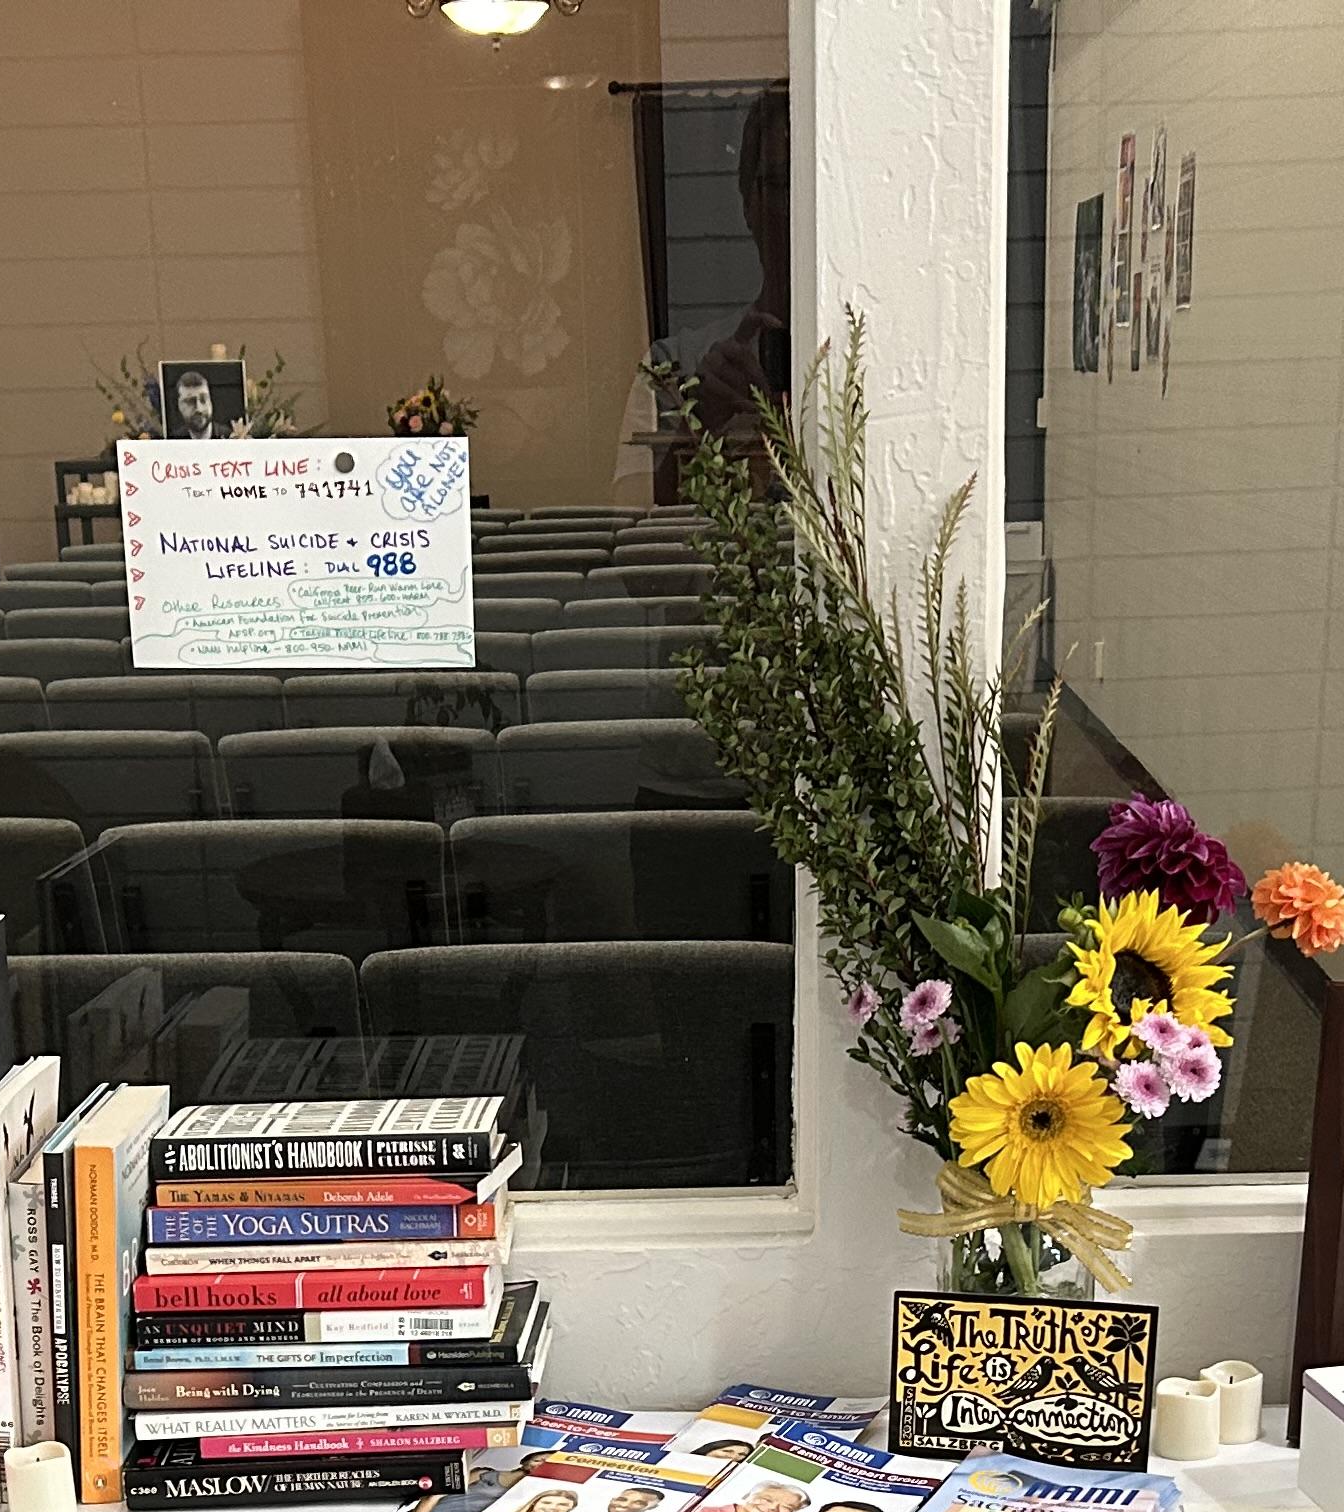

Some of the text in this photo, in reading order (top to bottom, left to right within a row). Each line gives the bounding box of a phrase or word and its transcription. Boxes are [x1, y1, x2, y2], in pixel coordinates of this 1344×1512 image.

[151, 461, 202, 483] CRISIS
[209, 460, 253, 477] TEXT
[220, 485, 268, 500] HOME
[294, 480, 375, 499] 741741
[159, 532, 258, 555] NATIONAL
[268, 533, 339, 549] SUICIDE
[370, 529, 431, 549] CRISIS
[325, 561, 360, 574] DIAL
[366, 552, 418, 577] 988
[161, 594, 283, 614] Other Resources
[238, 615, 295, 625] Foundation
[178, 1138, 283, 1172] ABOLITIONIST'S
[288, 1140, 363, 1169] HANDBOOK
[376, 1139, 437, 1154] PATRISSE
[377, 1153, 436, 1167] CULLORS
[169, 1190, 189, 1202] THE
[193, 1190, 234, 1202] YAMAS
[323, 1190, 364, 1203] Deborah
[366, 1190, 394, 1202] Adele
[165, 1215, 177, 1240] THE
[179, 1212, 192, 1242] PATH
[193, 1217, 204, 1235] OF
[206, 1215, 218, 1239] THE
[223, 1212, 389, 1236] YOGA SUTRAS
[237, 1257, 271, 1265] THINGS
[271, 1256, 293, 1265] FALL
[293, 1255, 321, 1264] APART
[155, 1283, 442, 1308] bell hooks all about love
[27, 1208, 47, 1426] ROSS GAY The Book of Delights
[143, 1320, 300, 1336] AN UNQUIET MIND
[952, 1309, 999, 1350] The
[1080, 1312, 1108, 1347] of
[95, 1274, 108, 1458] THE BRAIN THAT CHANGES ITSELF
[256, 1351, 394, 1365] THE GIFTS OF Imperfection
[897, 1338, 1009, 1396] Life is
[54, 1338, 70, 1405] APOCALYPSE
[175, 1383, 280, 1398] Being with Dying
[770, 1393, 818, 1407] NAMI
[565, 1407, 615, 1424] NAMI
[902, 1386, 915, 1441] SHARON
[946, 1394, 1005, 1428] Inter
[144, 1418, 193, 1436] WHAT
[195, 1416, 247, 1433] REALLY
[251, 1413, 317, 1431] MATTERS
[530, 1417, 621, 1438] Peer-to-Peer
[228, 1434, 461, 1453] the Kindness Handbook SHARON SALZBERG
[599, 1445, 651, 1461] NAMI
[824, 1441, 876, 1464] NAMI
[564, 1454, 660, 1475] Connection
[788, 1444, 833, 1466] Family
[833, 1458, 886, 1481] Support
[886, 1472, 929, 1485] Group
[1023, 1482, 1140, 1506] NAMI
